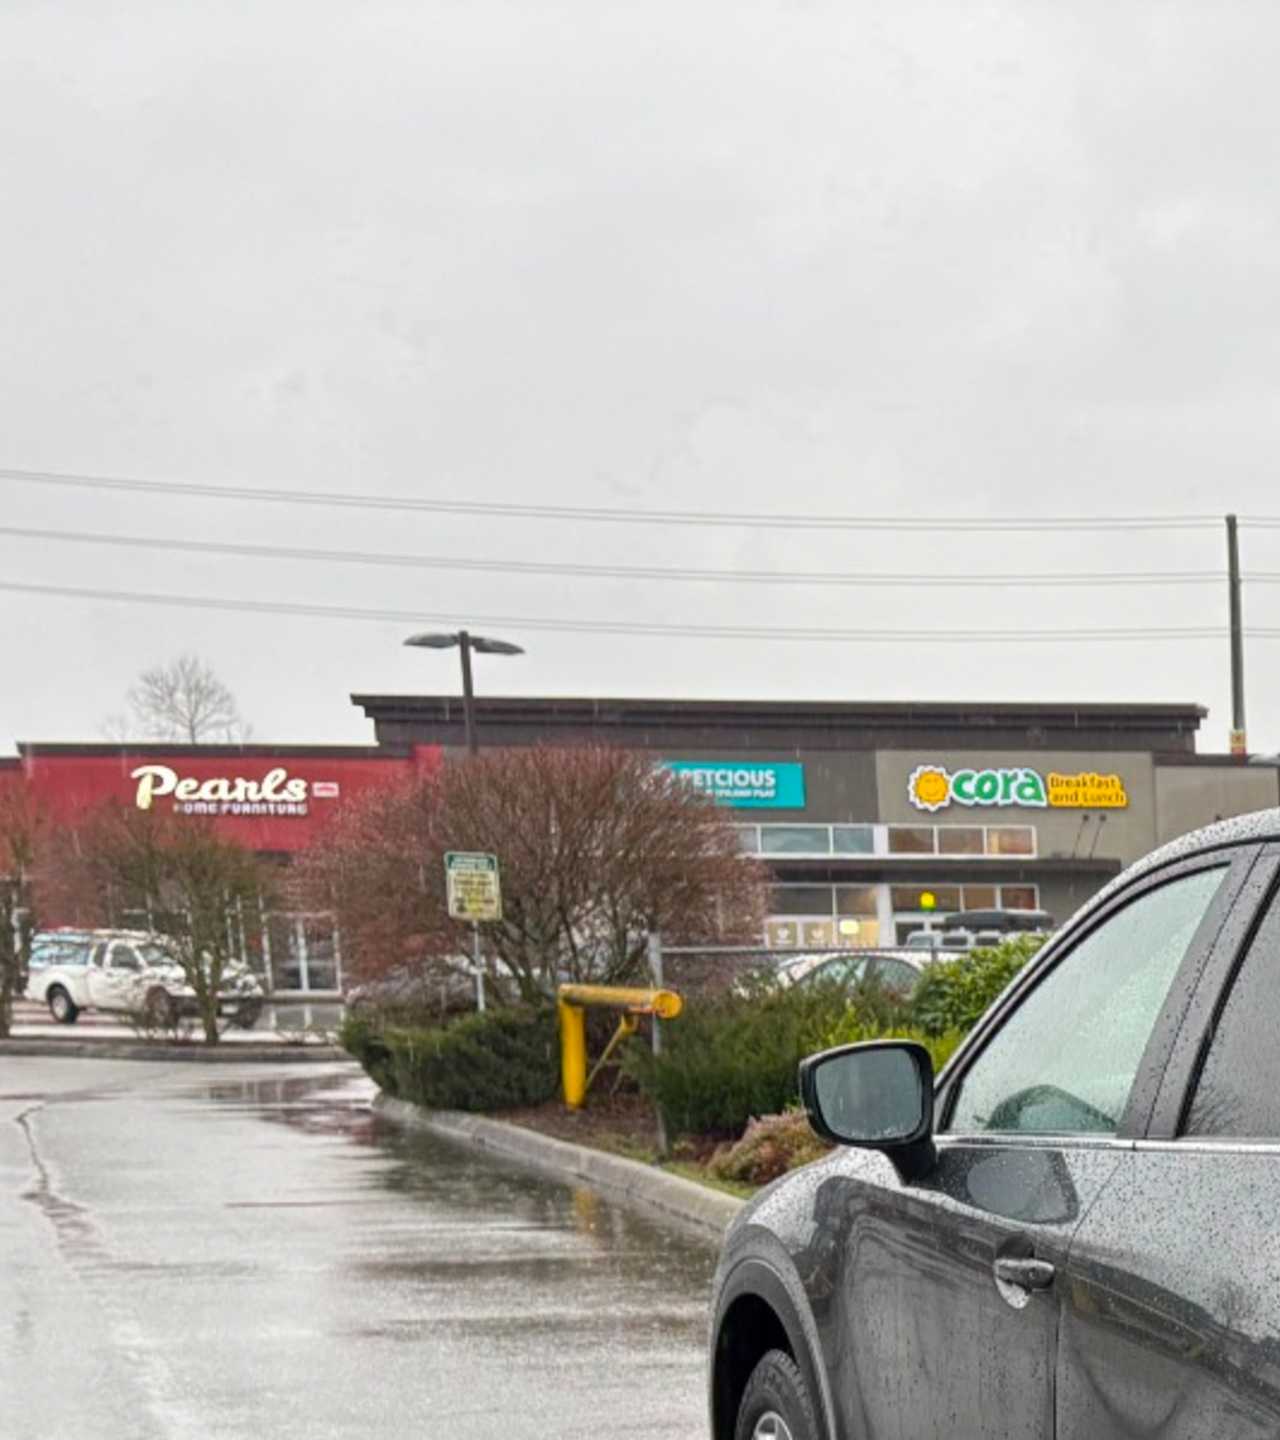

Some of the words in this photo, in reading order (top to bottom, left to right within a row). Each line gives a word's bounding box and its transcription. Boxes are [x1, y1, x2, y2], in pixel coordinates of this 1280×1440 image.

[131, 765, 308, 810] Pearls
[951, 770, 1046, 803] cora
[1051, 775, 1117, 789] Breakfast
[220, 802, 308, 816] FURNITURE
